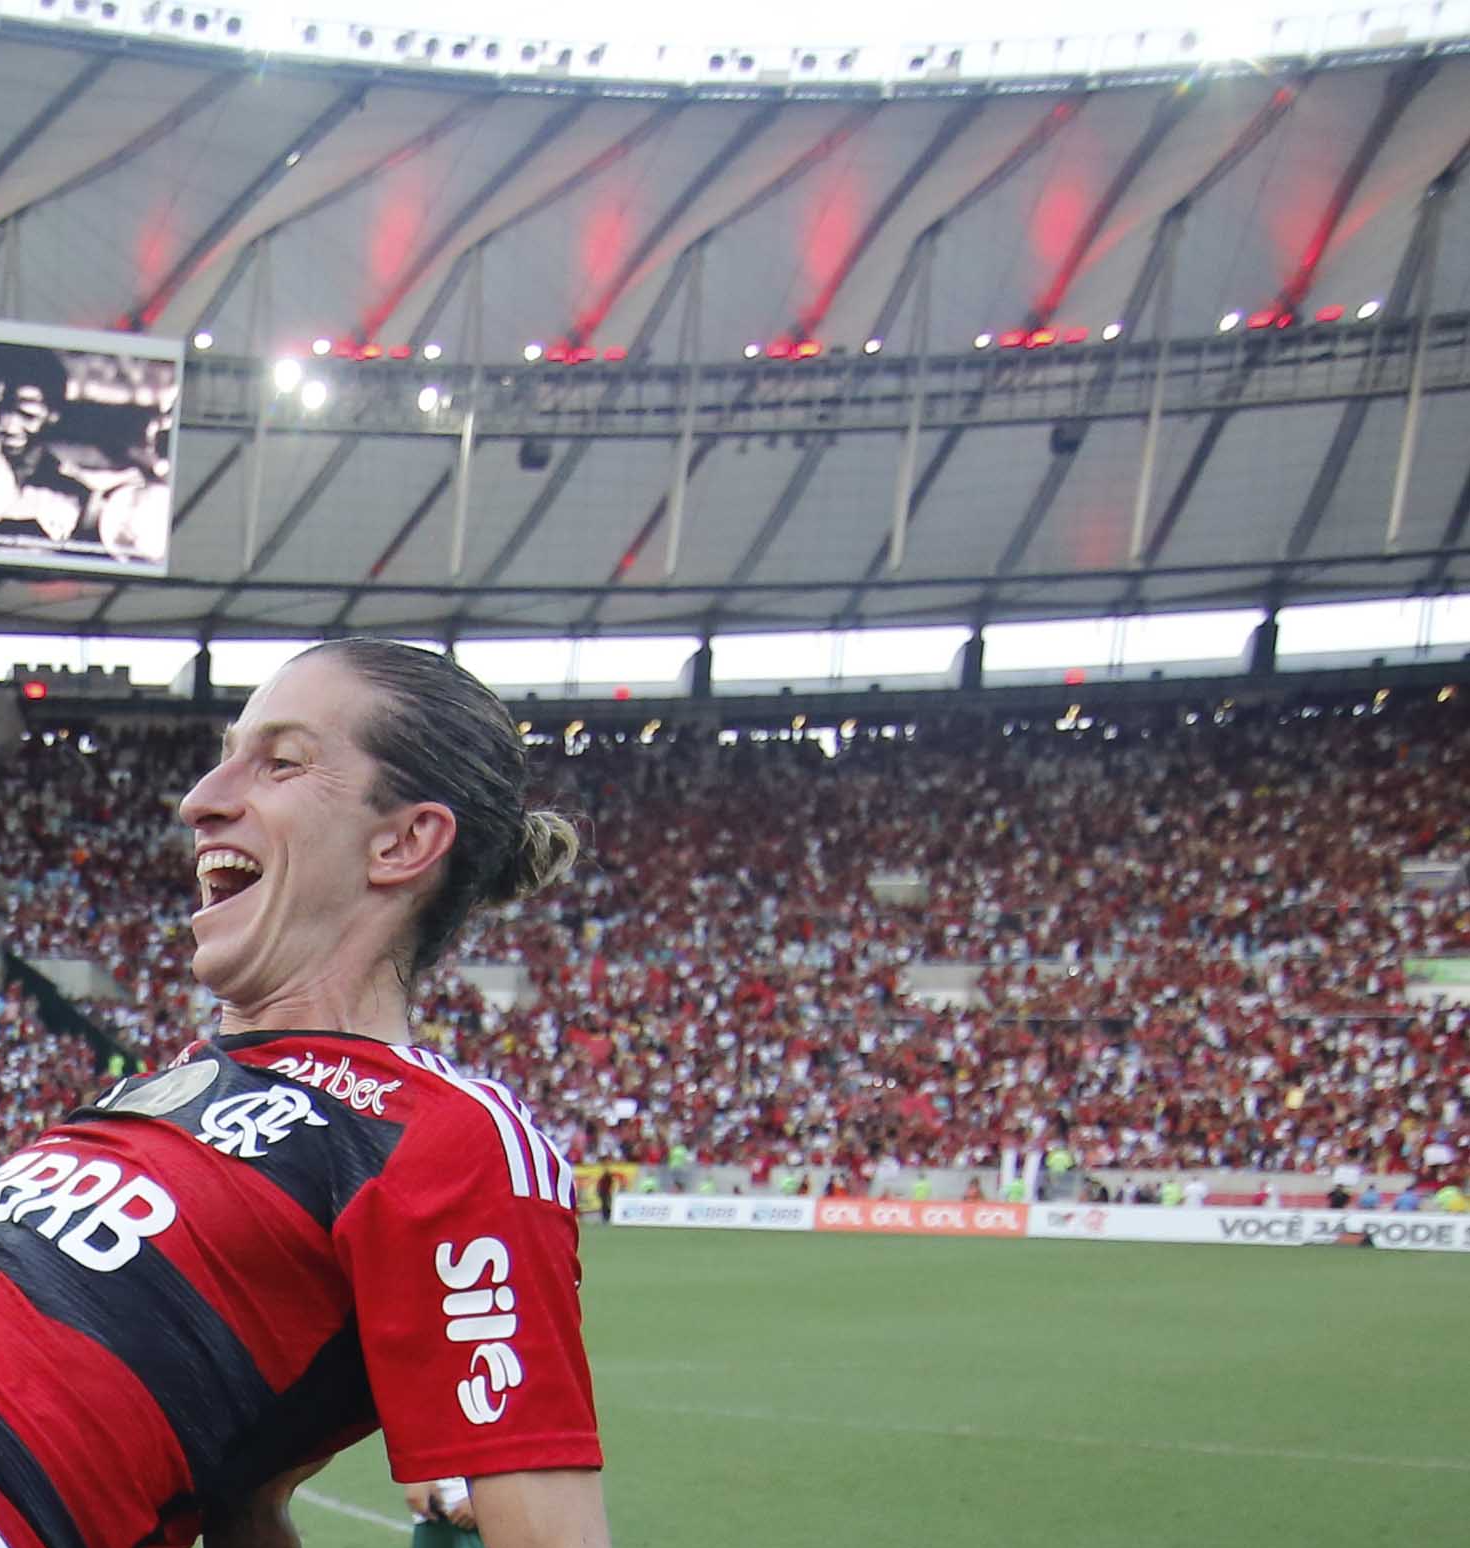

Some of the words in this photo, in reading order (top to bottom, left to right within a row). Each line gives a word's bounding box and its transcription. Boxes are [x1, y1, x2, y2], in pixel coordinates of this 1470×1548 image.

[268, 1052, 403, 1116] pixbet
[821, 1206, 862, 1225] GOL
[871, 1206, 914, 1227] GOL
[921, 1206, 966, 1228] GOL
[974, 1208, 1019, 1230] GOL
[1220, 1214, 1303, 1238] VOCÊ
